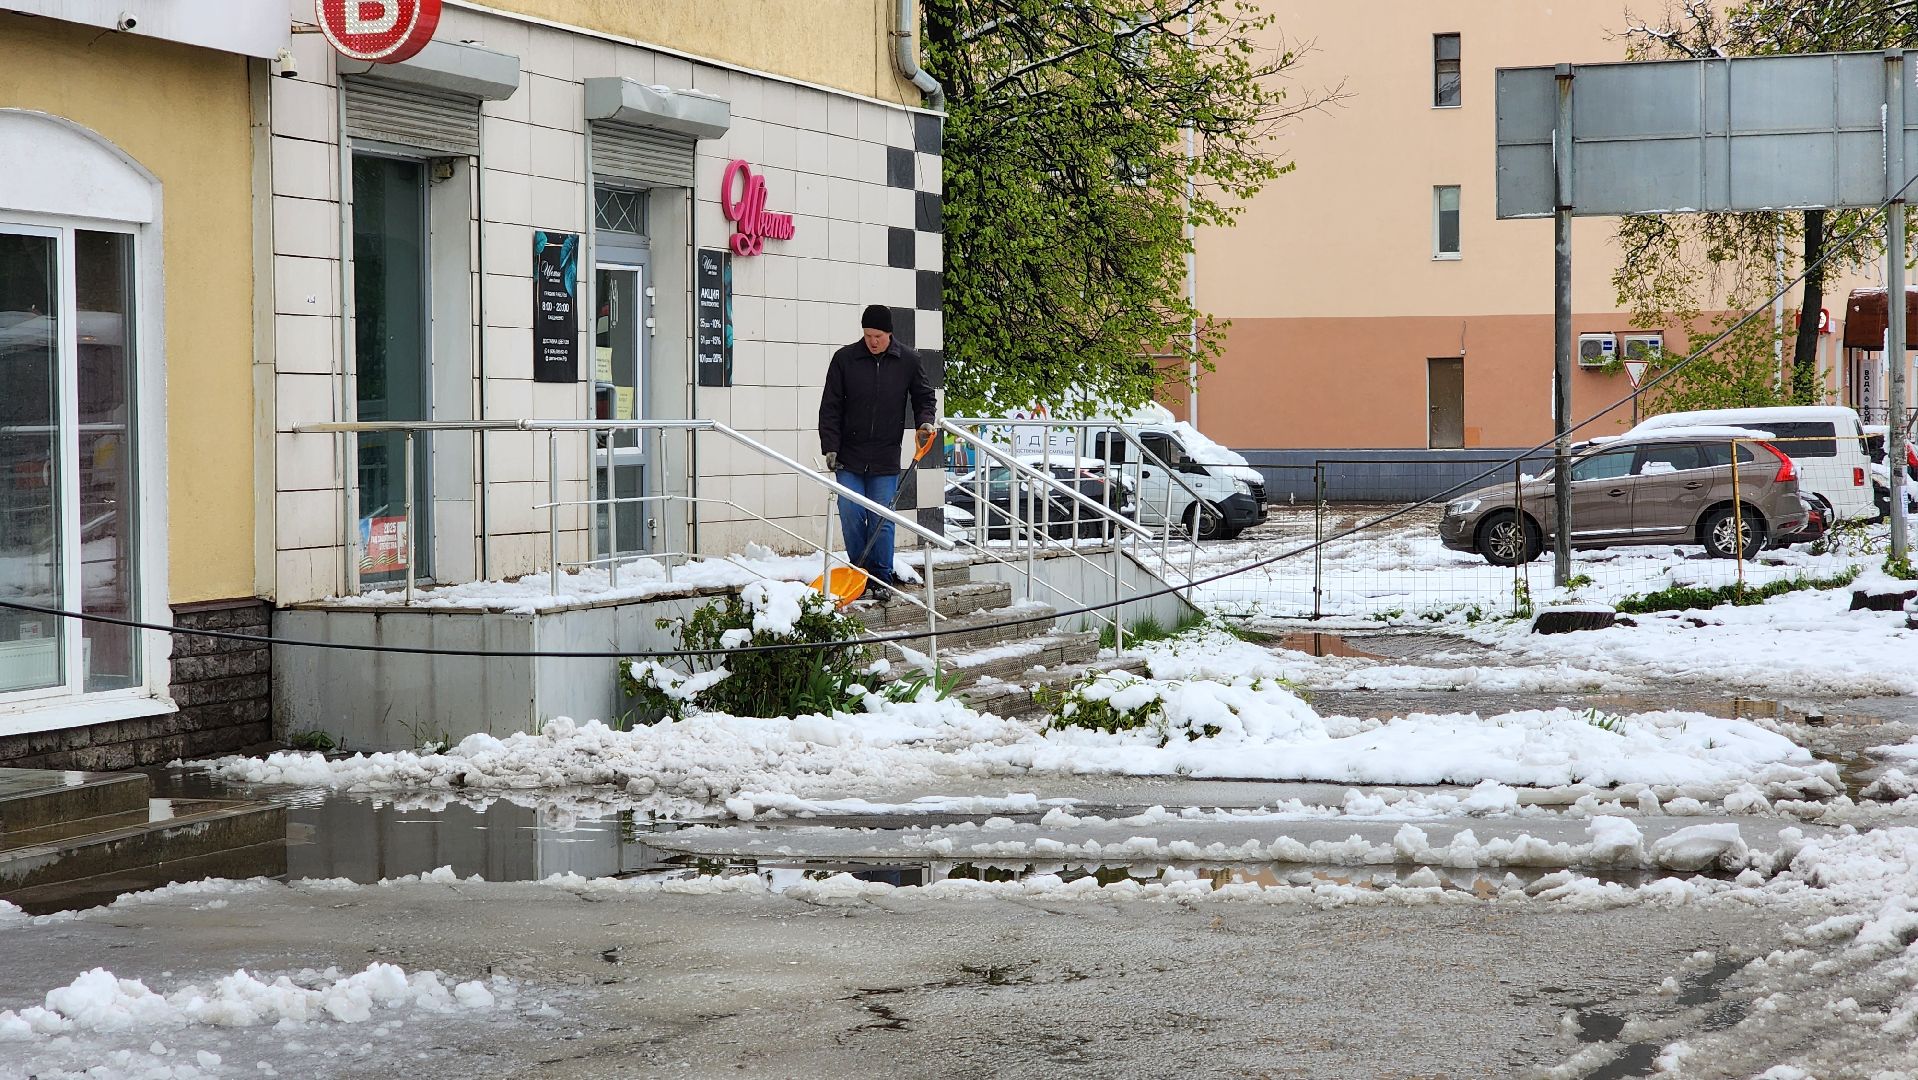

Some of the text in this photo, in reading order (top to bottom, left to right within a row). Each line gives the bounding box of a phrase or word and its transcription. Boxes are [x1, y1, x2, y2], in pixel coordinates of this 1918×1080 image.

[722, 160, 795, 256] Цветы
[701, 288, 719, 300] АКЦИЯ
[384, 522, 396, 534] 2025
